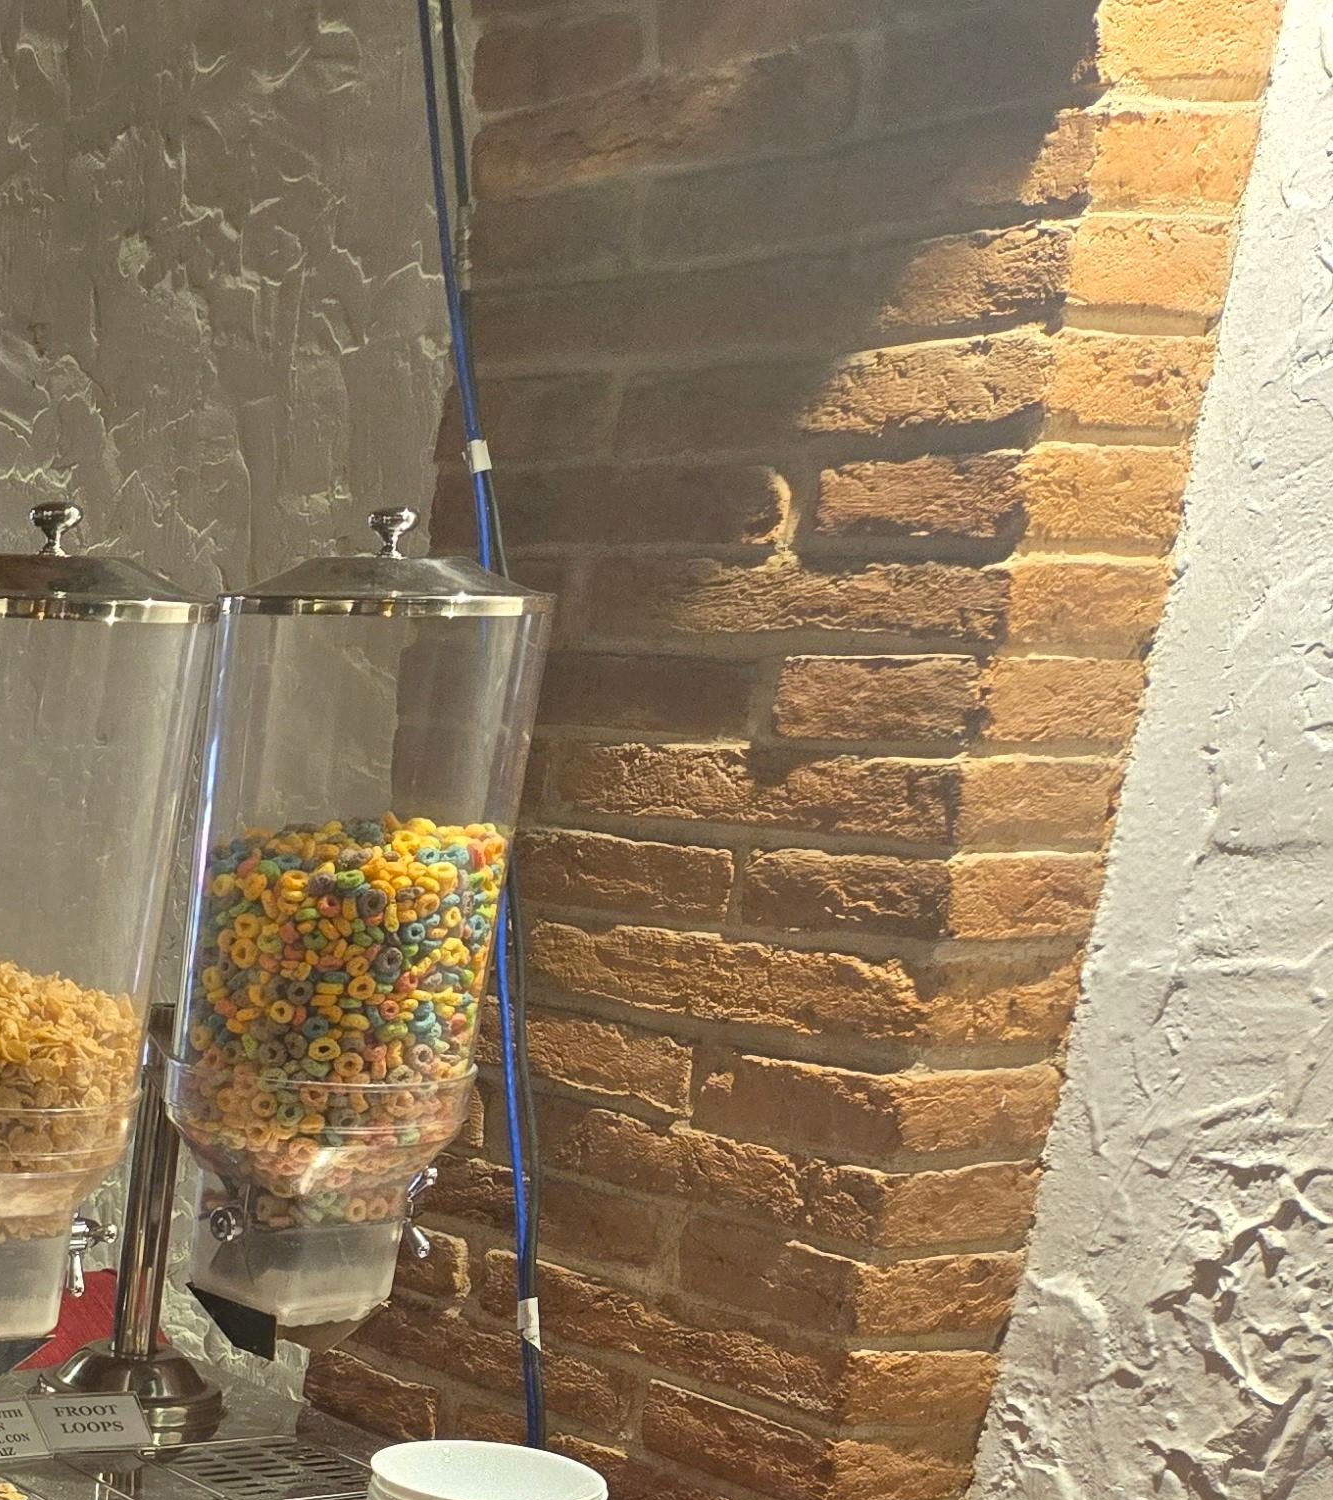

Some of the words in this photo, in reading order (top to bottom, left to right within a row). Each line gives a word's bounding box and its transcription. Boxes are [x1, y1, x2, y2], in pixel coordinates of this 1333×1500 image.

[53, 1404, 118, 1418] FROOT
[61, 1420, 125, 1434] LOOPS
[5, 1432, 31, 1443] CON
